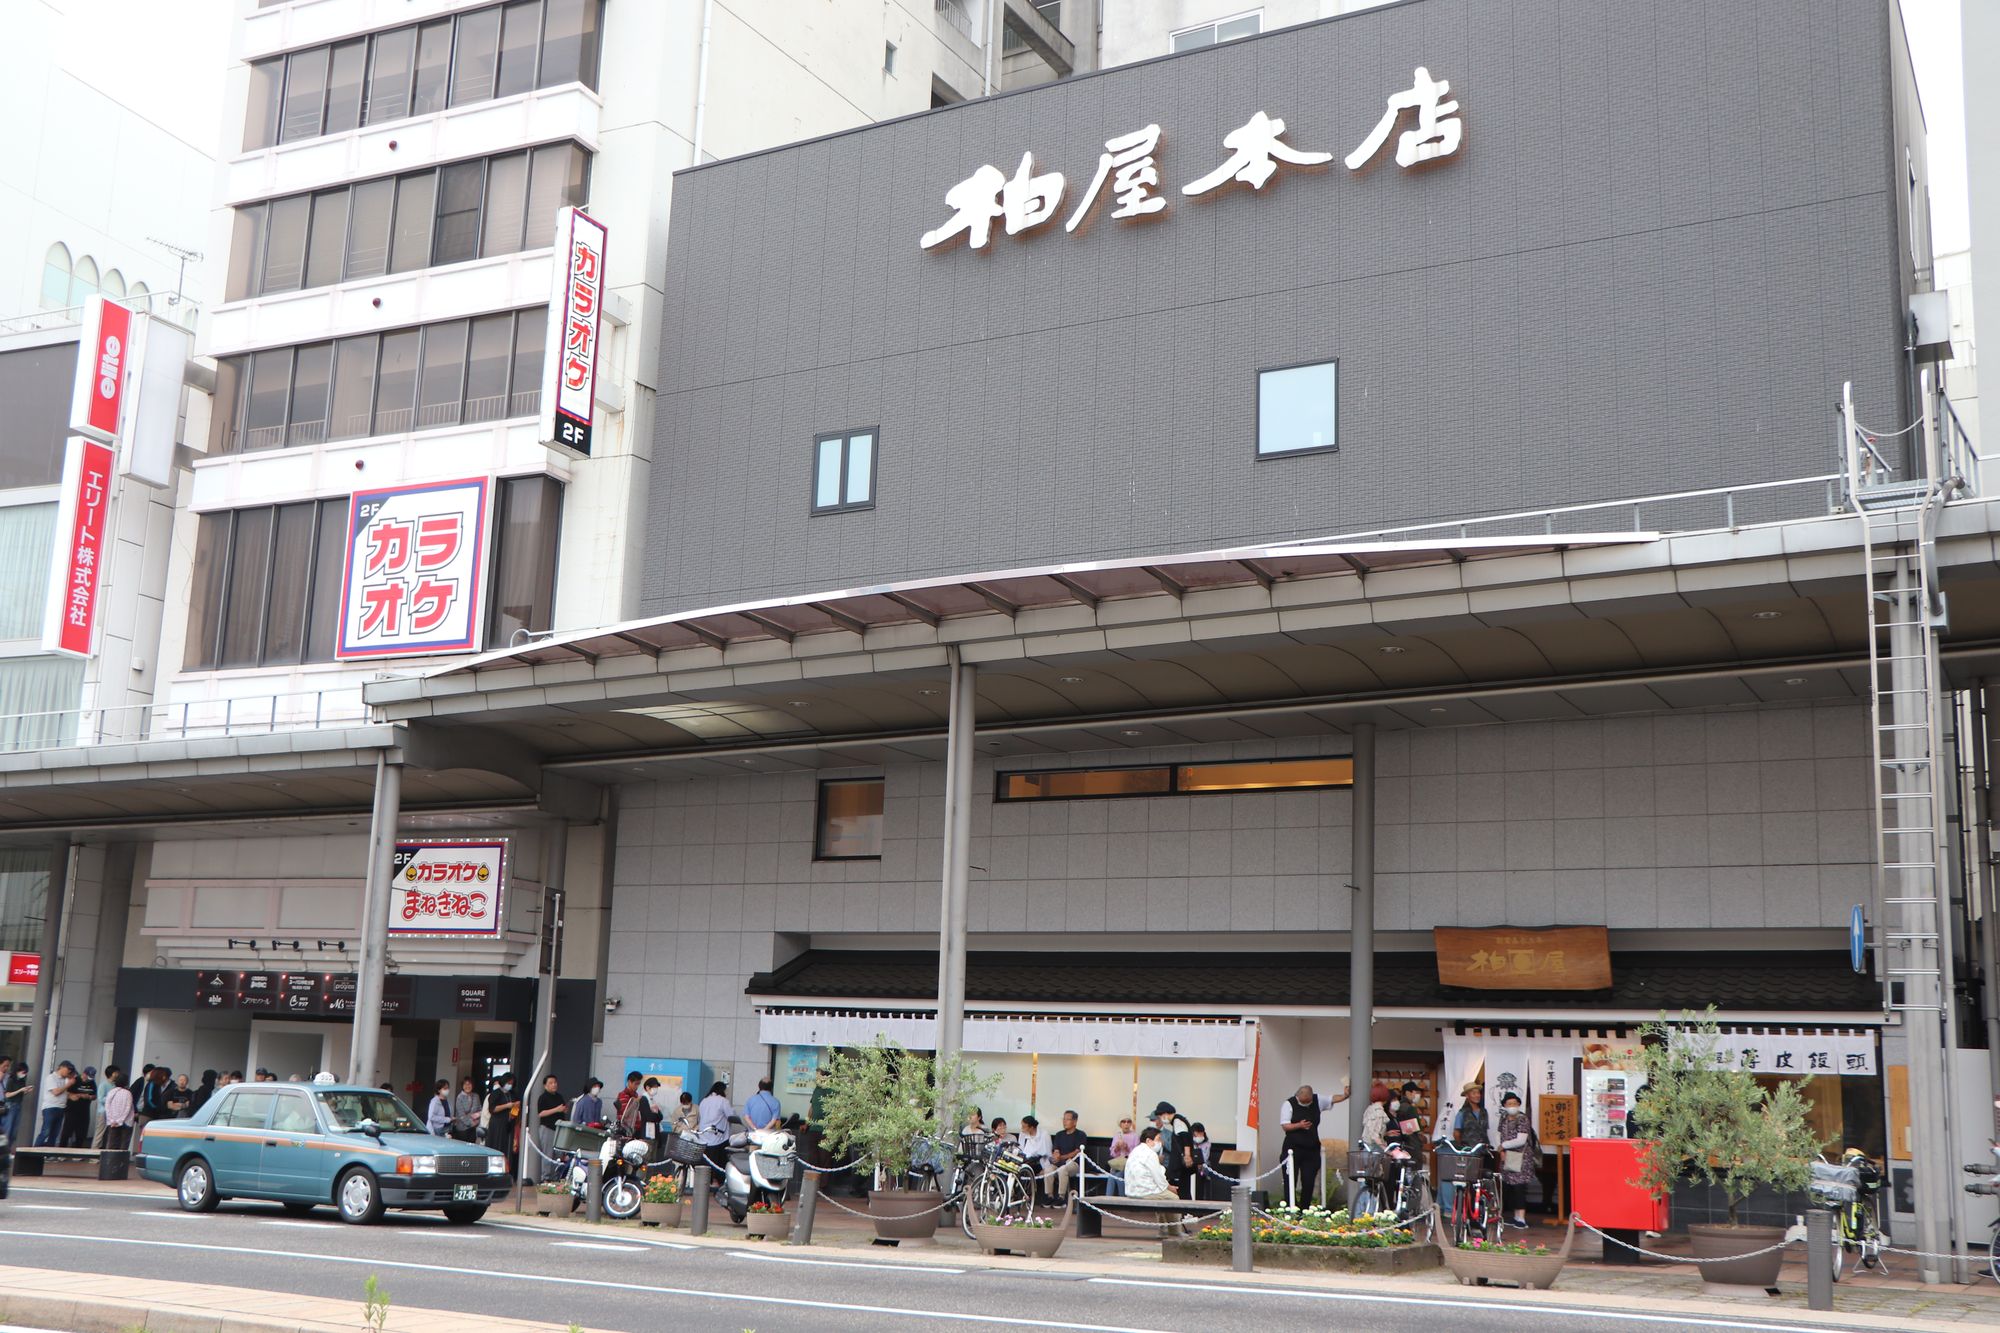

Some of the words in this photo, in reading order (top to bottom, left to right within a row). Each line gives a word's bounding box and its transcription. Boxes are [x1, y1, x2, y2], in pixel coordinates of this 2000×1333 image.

[920, 66, 1463, 250] 柏屋本店
[567, 243, 598, 390] カラオケ
[100, 335, 121, 399] elite
[562, 422, 585, 444] 2F
[360, 503, 380, 518] 2F
[70, 471, 103, 627] エリート株式会社
[393, 853, 411, 864] 2F
[416, 862, 459, 882] カラオケ
[402, 889, 487, 920] まねきねこ
[461, 989, 486, 997] SQUARE
